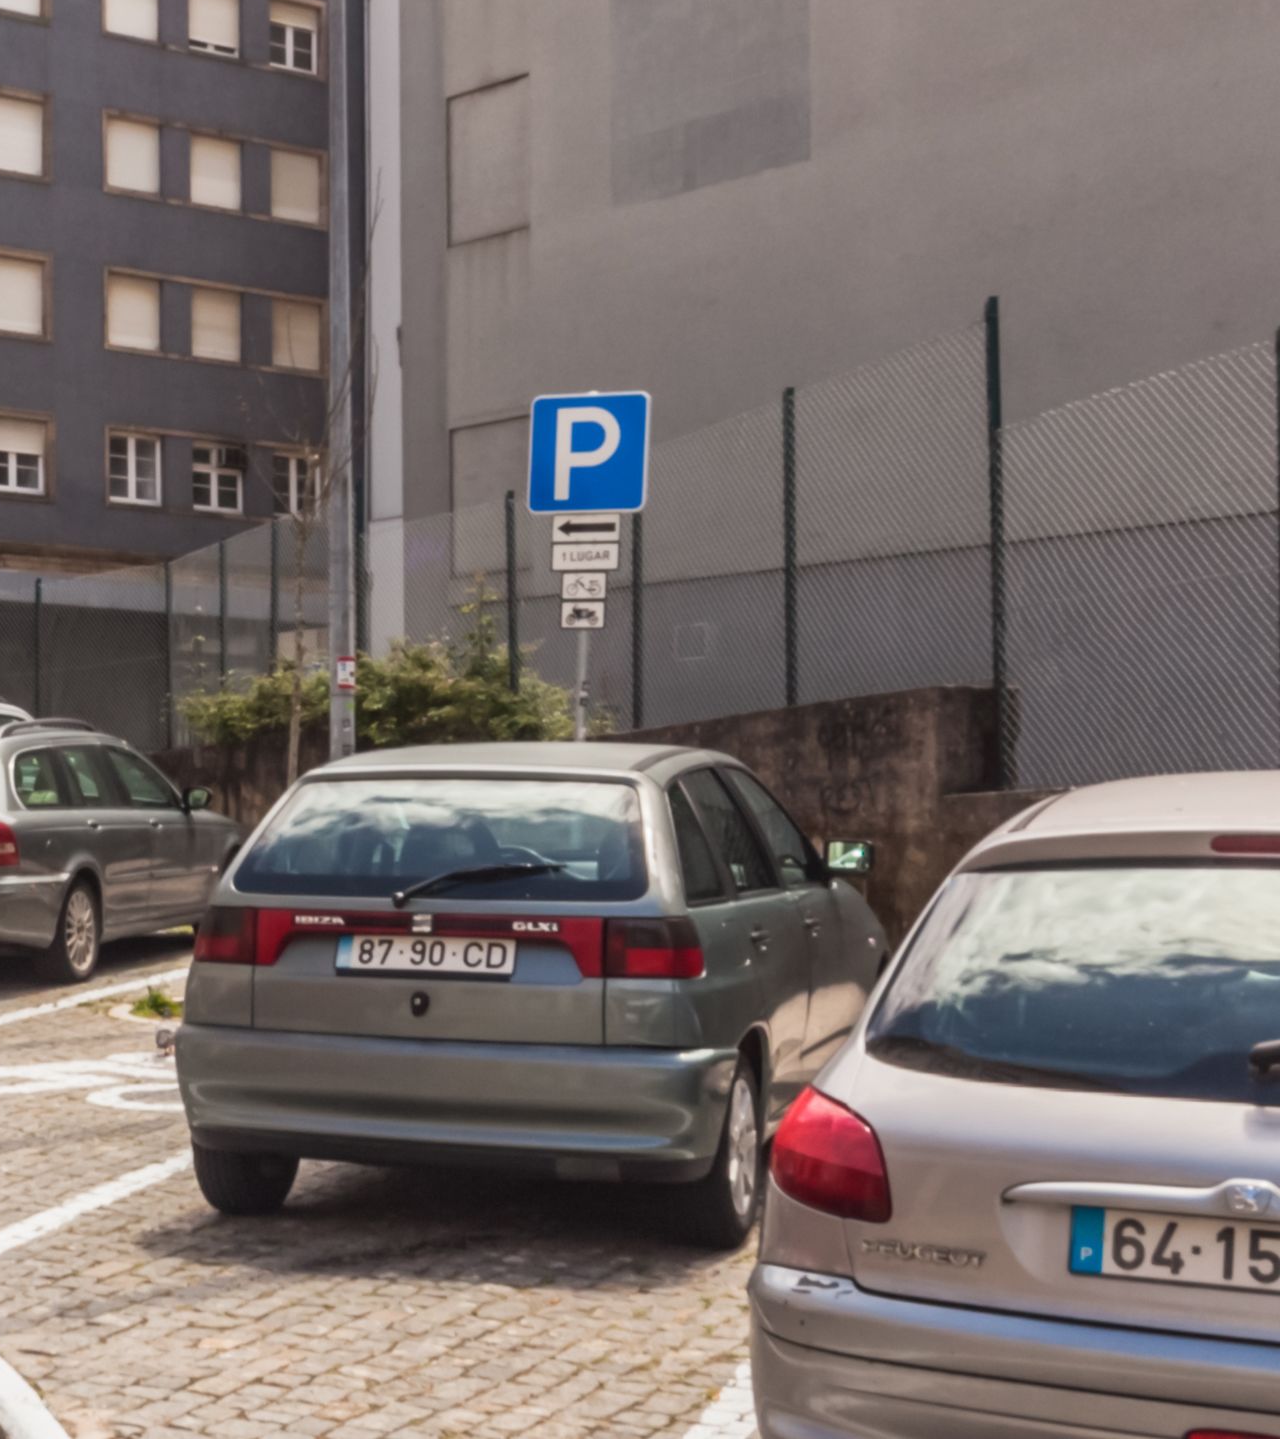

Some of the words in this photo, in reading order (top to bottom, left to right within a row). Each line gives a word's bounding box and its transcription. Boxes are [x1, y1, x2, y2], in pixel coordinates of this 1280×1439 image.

[553, 406, 621, 501] P
[569, 550, 610, 562] LUGAR
[295, 915, 345, 926] IBIZA
[861, 1239, 988, 1269] PEUGEOT
[1080, 1246, 1093, 1261] P
